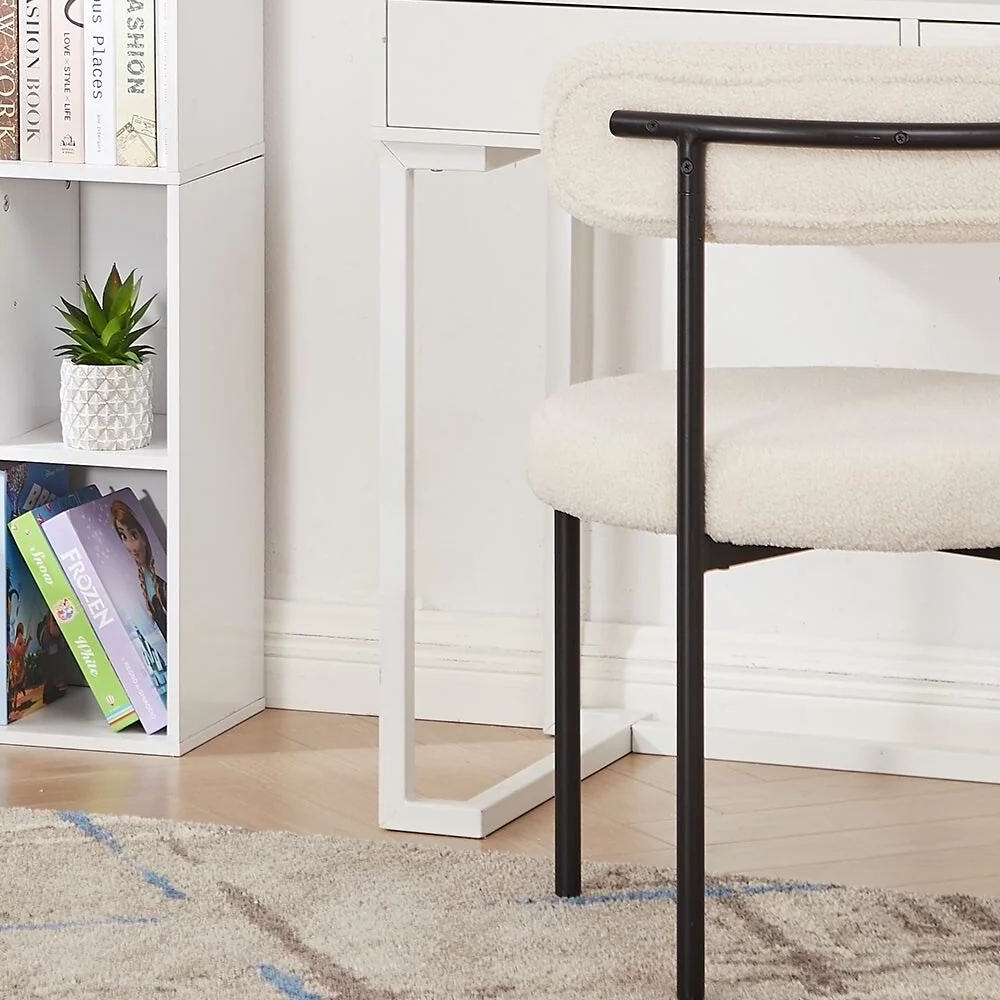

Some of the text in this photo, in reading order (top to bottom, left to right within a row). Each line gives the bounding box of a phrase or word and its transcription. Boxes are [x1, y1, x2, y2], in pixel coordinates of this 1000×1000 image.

[63, 32, 71, 57] LOVE
[92, 35, 106, 100] Places
[26, 77, 41, 142] BOOK
[63, 66, 71, 94] STYLE
[63, 103, 71, 121] LIFE
[29, 546, 99, 678] Snow White
[60, 547, 115, 630] FROZEN
